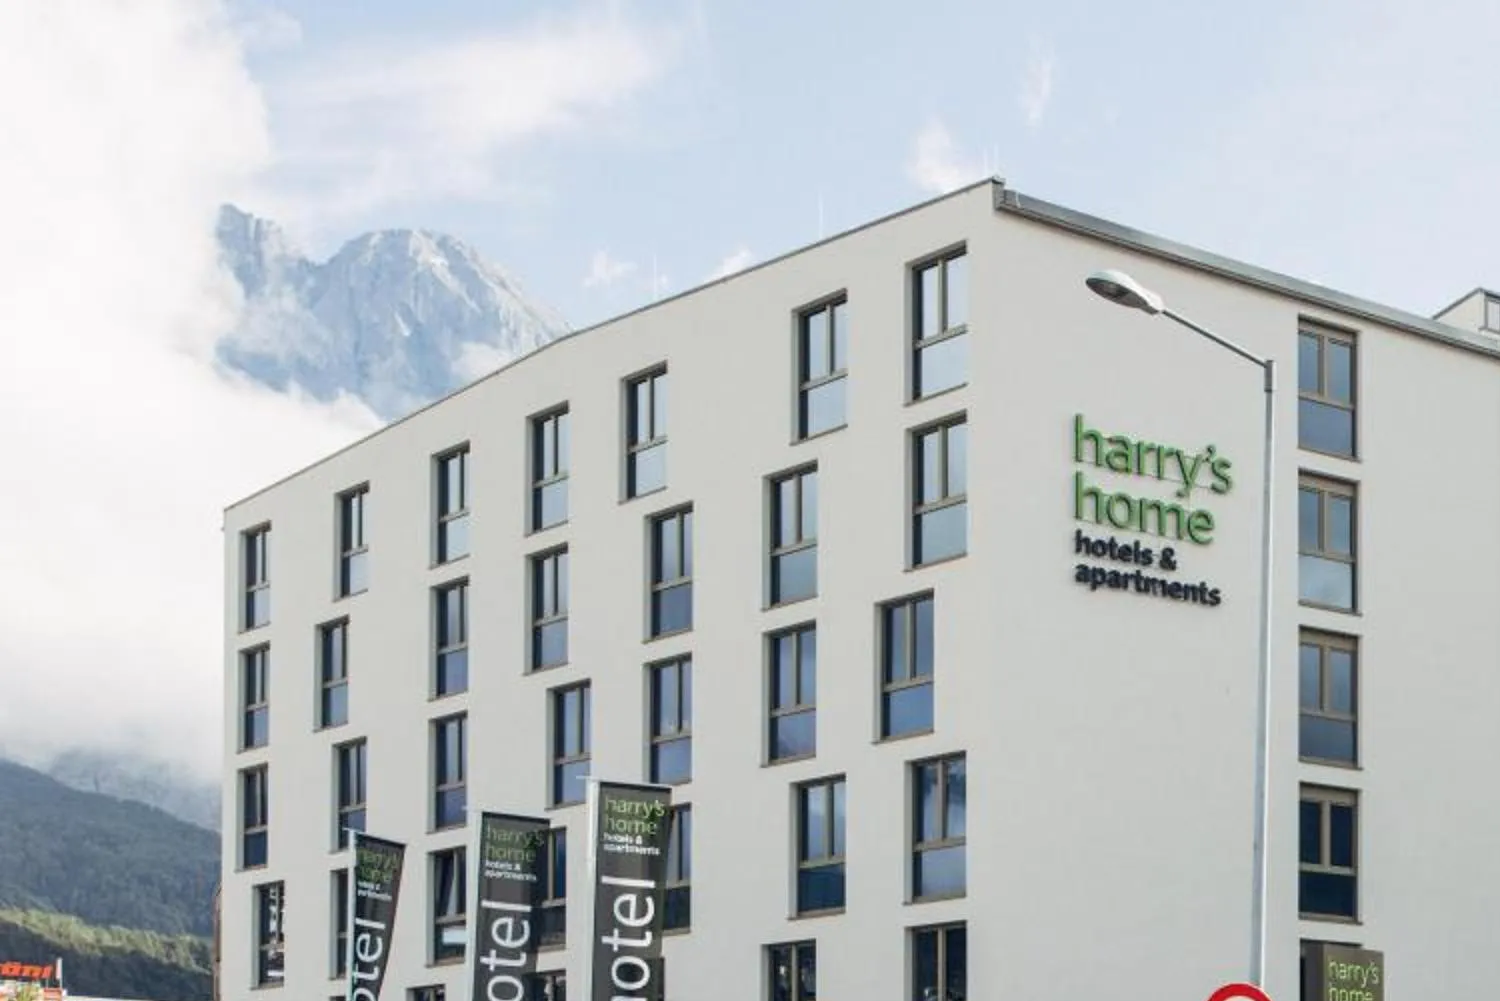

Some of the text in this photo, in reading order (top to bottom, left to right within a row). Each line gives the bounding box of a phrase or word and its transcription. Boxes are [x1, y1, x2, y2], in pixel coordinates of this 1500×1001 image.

[1073, 413, 1233, 498] harry's
[1073, 470, 1215, 545] home
[1074, 528, 1178, 571] hotels &
[1074, 563, 1222, 606] apartments
[604, 795, 666, 819] harry's
[604, 814, 658, 835] home
[1328, 955, 1380, 988] harry's
